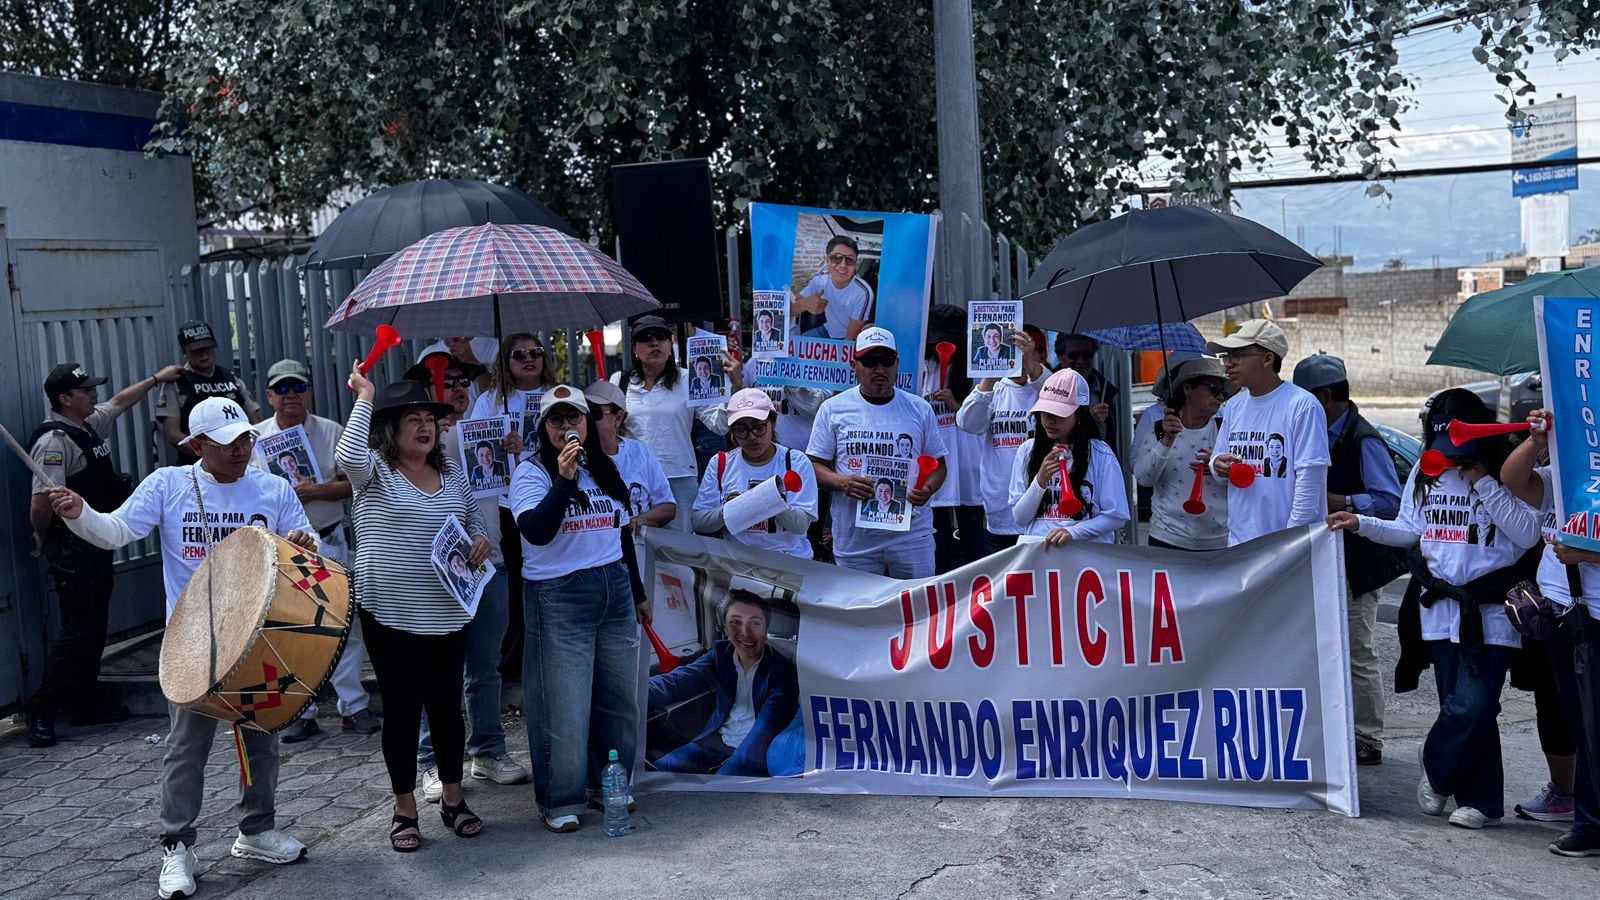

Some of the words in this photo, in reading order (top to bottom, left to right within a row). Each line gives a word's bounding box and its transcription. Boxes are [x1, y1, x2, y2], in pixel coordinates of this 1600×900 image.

[1001, 305, 1015, 313] PARA
[974, 313, 1015, 323] FERNANDO!
[799, 341, 837, 362] LUCHA
[781, 362, 800, 379] PARA
[804, 365, 847, 384] FERNANDO
[194, 381, 237, 394] POLICIA
[1011, 410, 1026, 418] PARA
[489, 420, 503, 429] PARA
[285, 430, 299, 440] PARA
[463, 428, 505, 442] FERNANDO!
[846, 431, 874, 441] JUSTICIA
[875, 432, 894, 441] PARA
[1250, 431, 1265, 442] PARA
[264, 437, 302, 456] FERNANDO!
[846, 442, 894, 457] FERNANDO
[895, 461, 909, 470] PARA
[866, 466, 908, 480] FERNANDO!
[1450, 495, 1471, 507] PARA
[222, 512, 245, 523] PARA
[182, 546, 206, 560] ¡PENA
[890, 569, 1184, 671] JUSTICIA
[810, 694, 1002, 780] FERNANDO
[1012, 689, 1206, 790] ENRIQUEZ
[1213, 688, 1312, 781] RUIZ
